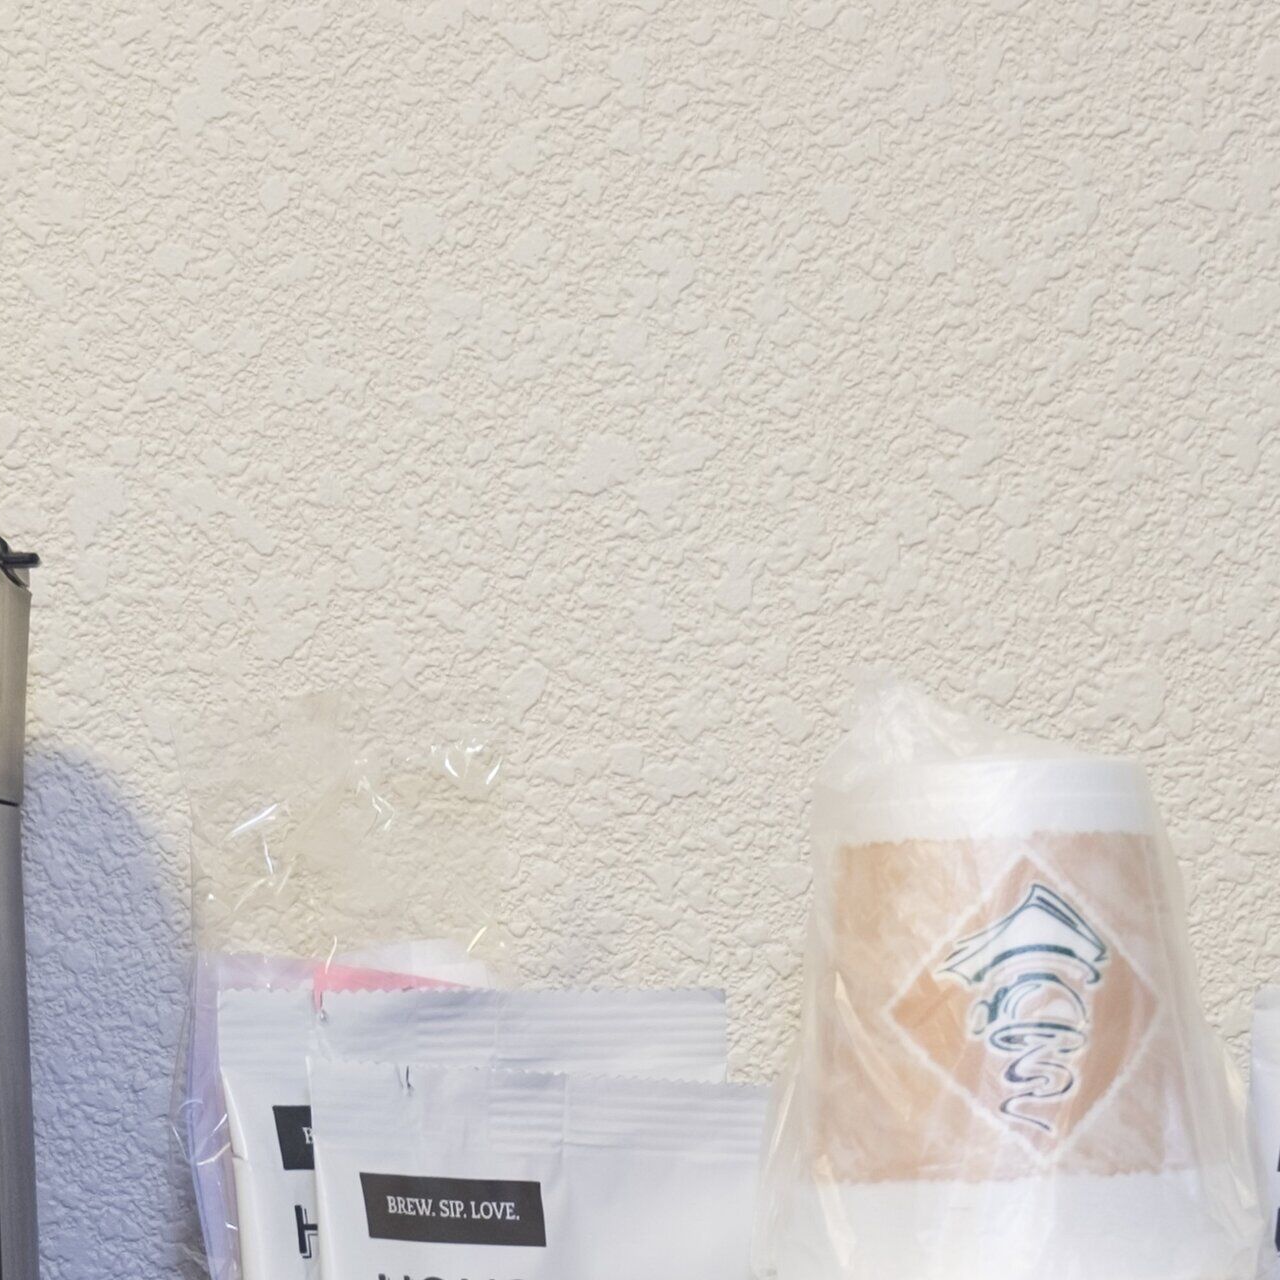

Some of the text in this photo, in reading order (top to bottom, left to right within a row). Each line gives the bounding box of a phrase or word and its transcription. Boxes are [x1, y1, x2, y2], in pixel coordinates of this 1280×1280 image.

[386, 1195, 521, 1221] BREW. SIP. LOVE.
